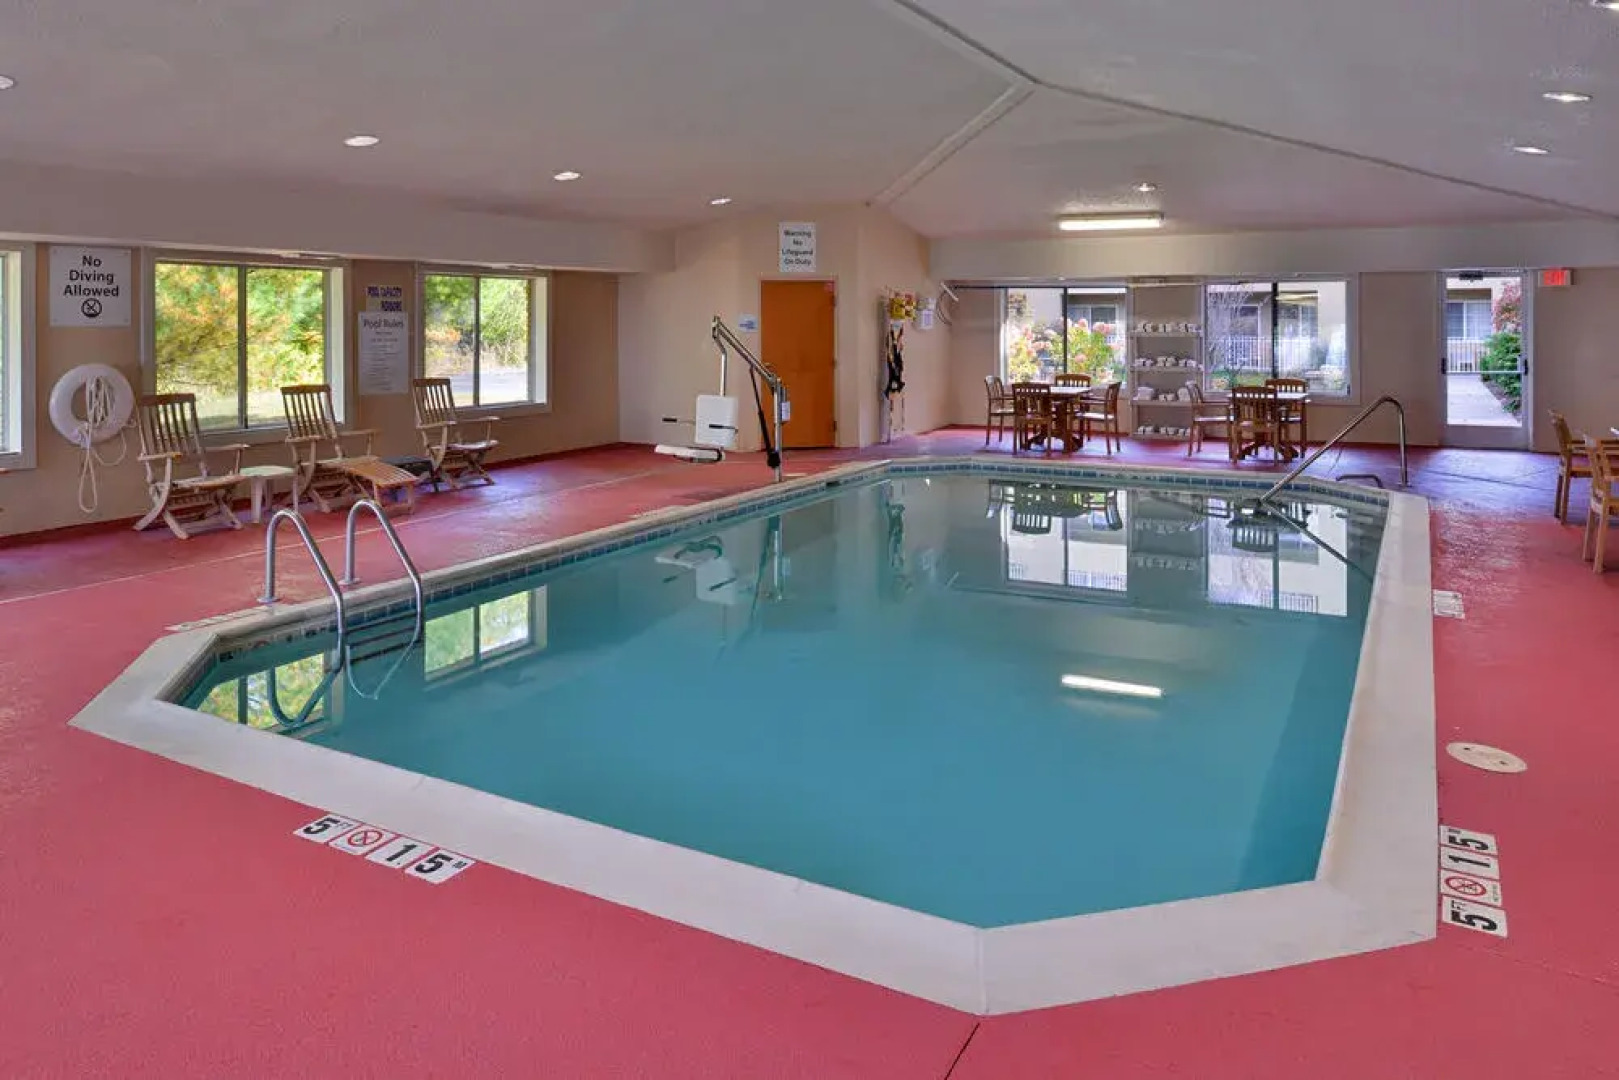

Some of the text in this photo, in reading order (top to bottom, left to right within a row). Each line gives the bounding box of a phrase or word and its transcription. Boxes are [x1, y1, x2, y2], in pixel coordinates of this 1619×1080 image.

[82, 255, 102, 267] No
[69, 269, 114, 286] Diving
[63, 284, 119, 297] Allowed
[363, 318, 381, 329] Pool
